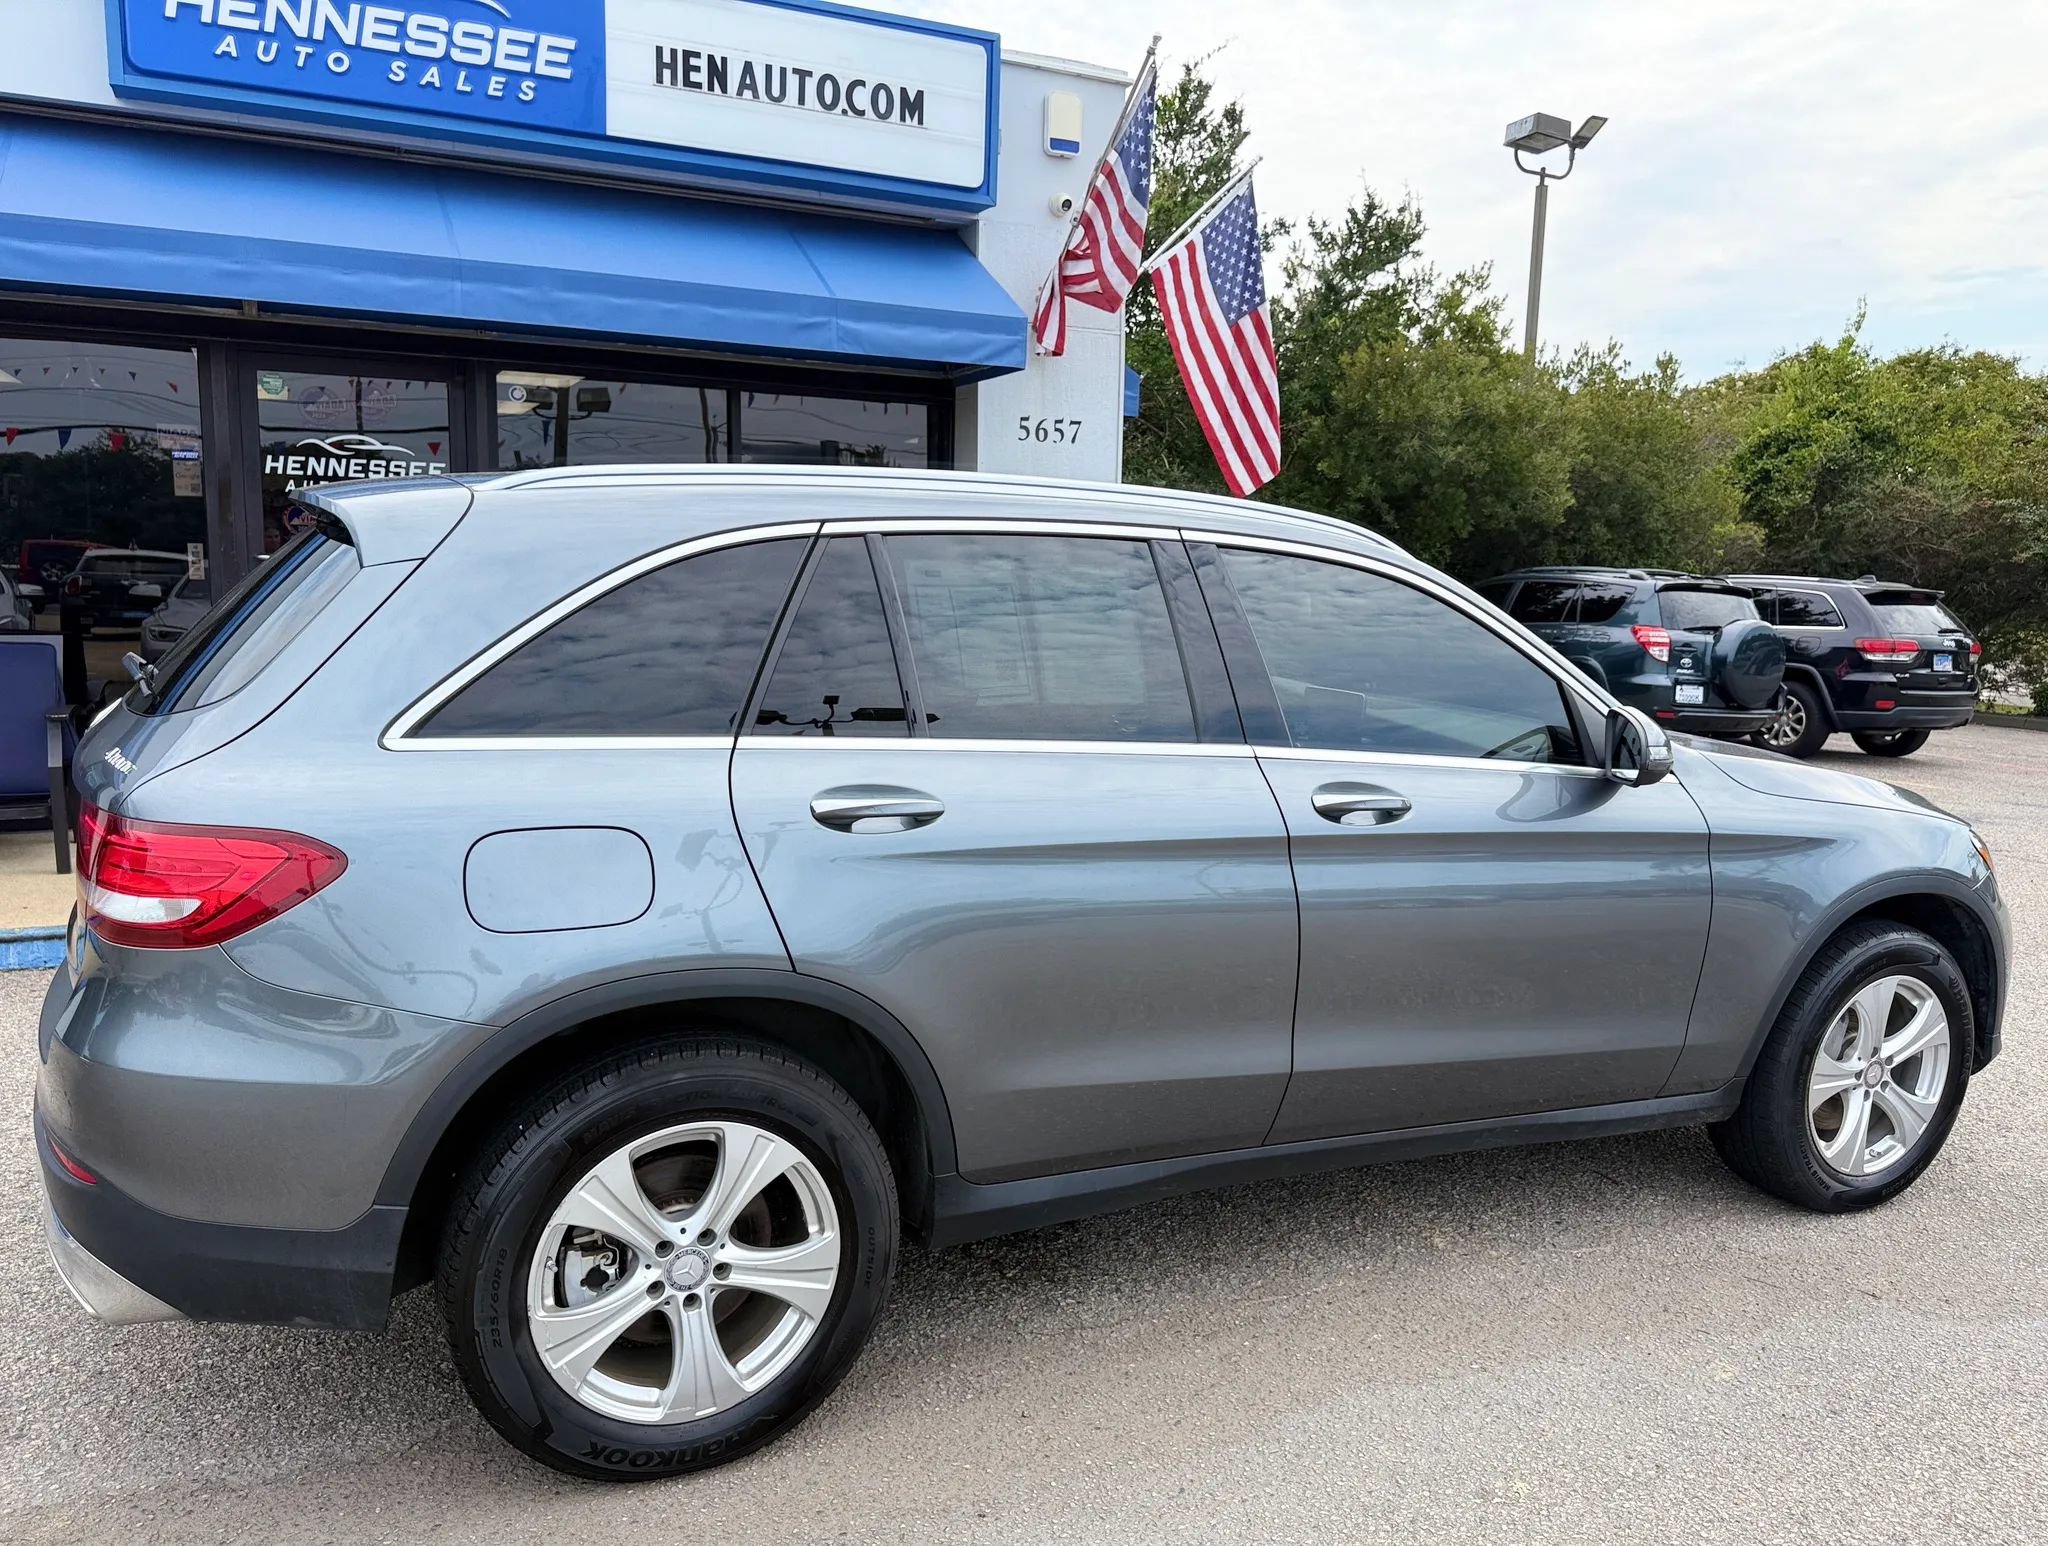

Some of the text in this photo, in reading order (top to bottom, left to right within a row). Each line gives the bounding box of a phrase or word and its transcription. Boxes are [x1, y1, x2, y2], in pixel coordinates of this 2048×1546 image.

[215, 35, 537, 102] AUTO SALES
[1018, 415, 1082, 444] 5657
[265, 455, 446, 478] HENNESSEE
[489, 1247, 508, 1349] 235/60R18
